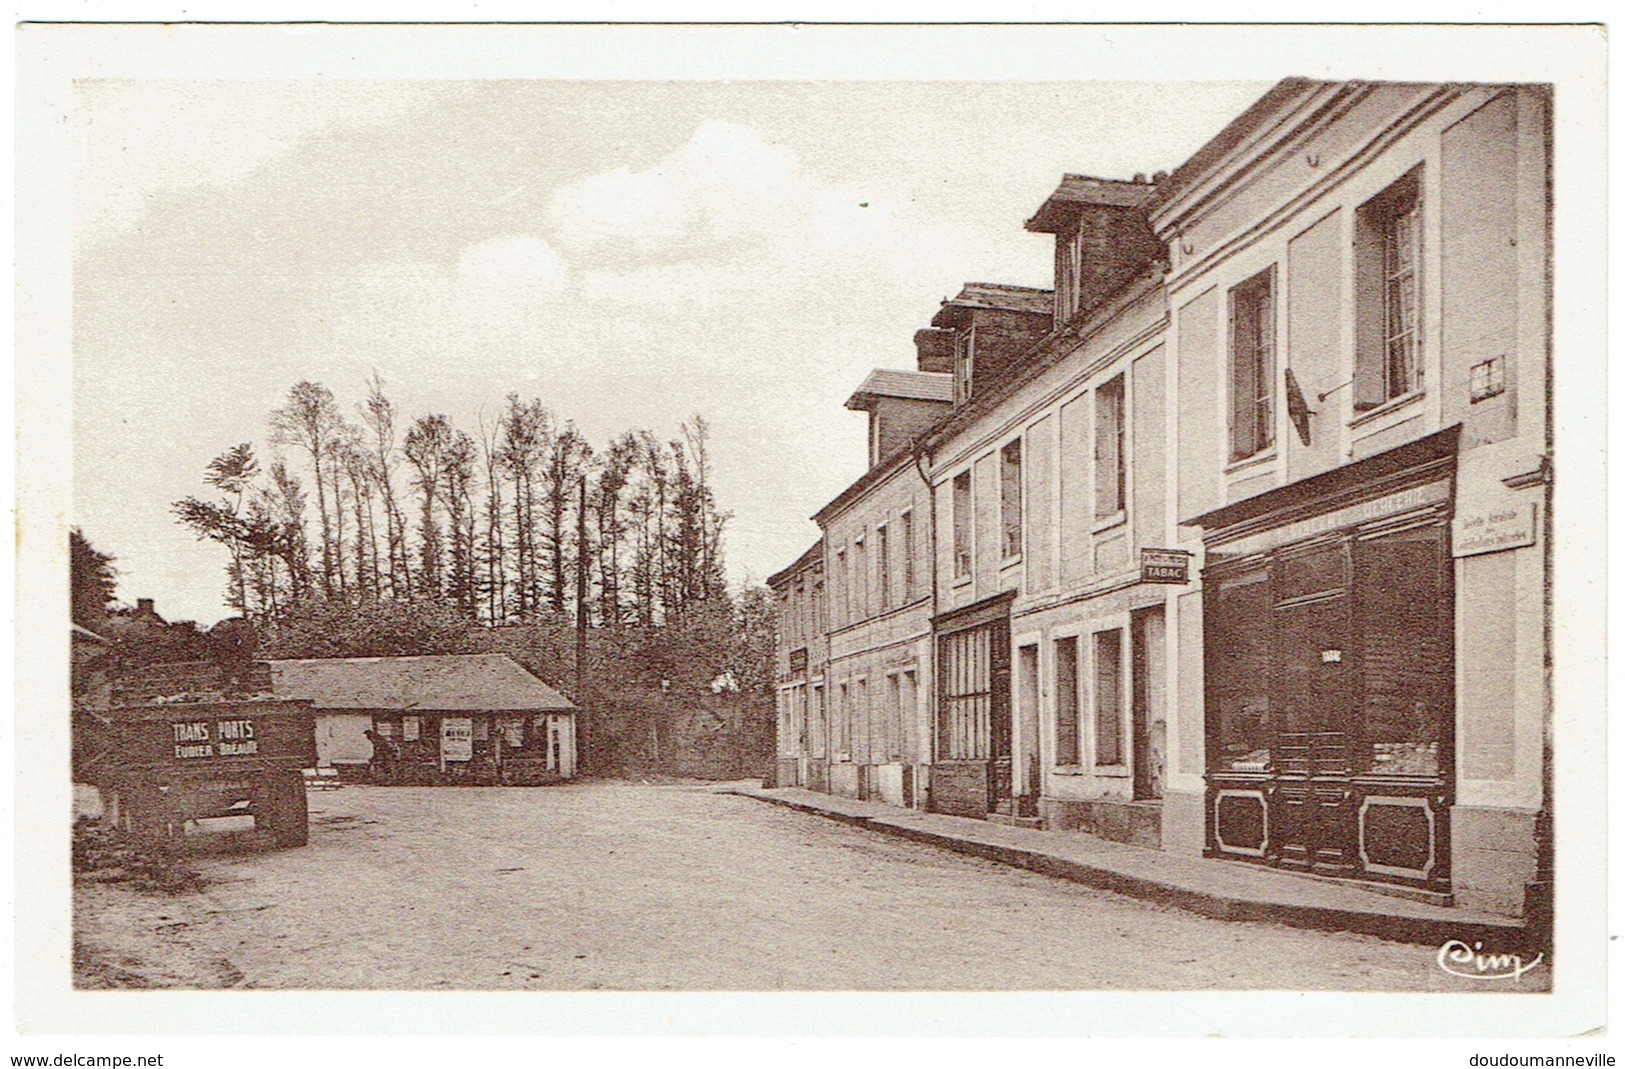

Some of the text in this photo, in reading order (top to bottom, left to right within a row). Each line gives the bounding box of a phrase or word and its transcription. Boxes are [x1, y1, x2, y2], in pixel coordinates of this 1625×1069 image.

[1147, 567, 1182, 577] TABAC
[173, 720, 253, 741] TRANS PORTS
